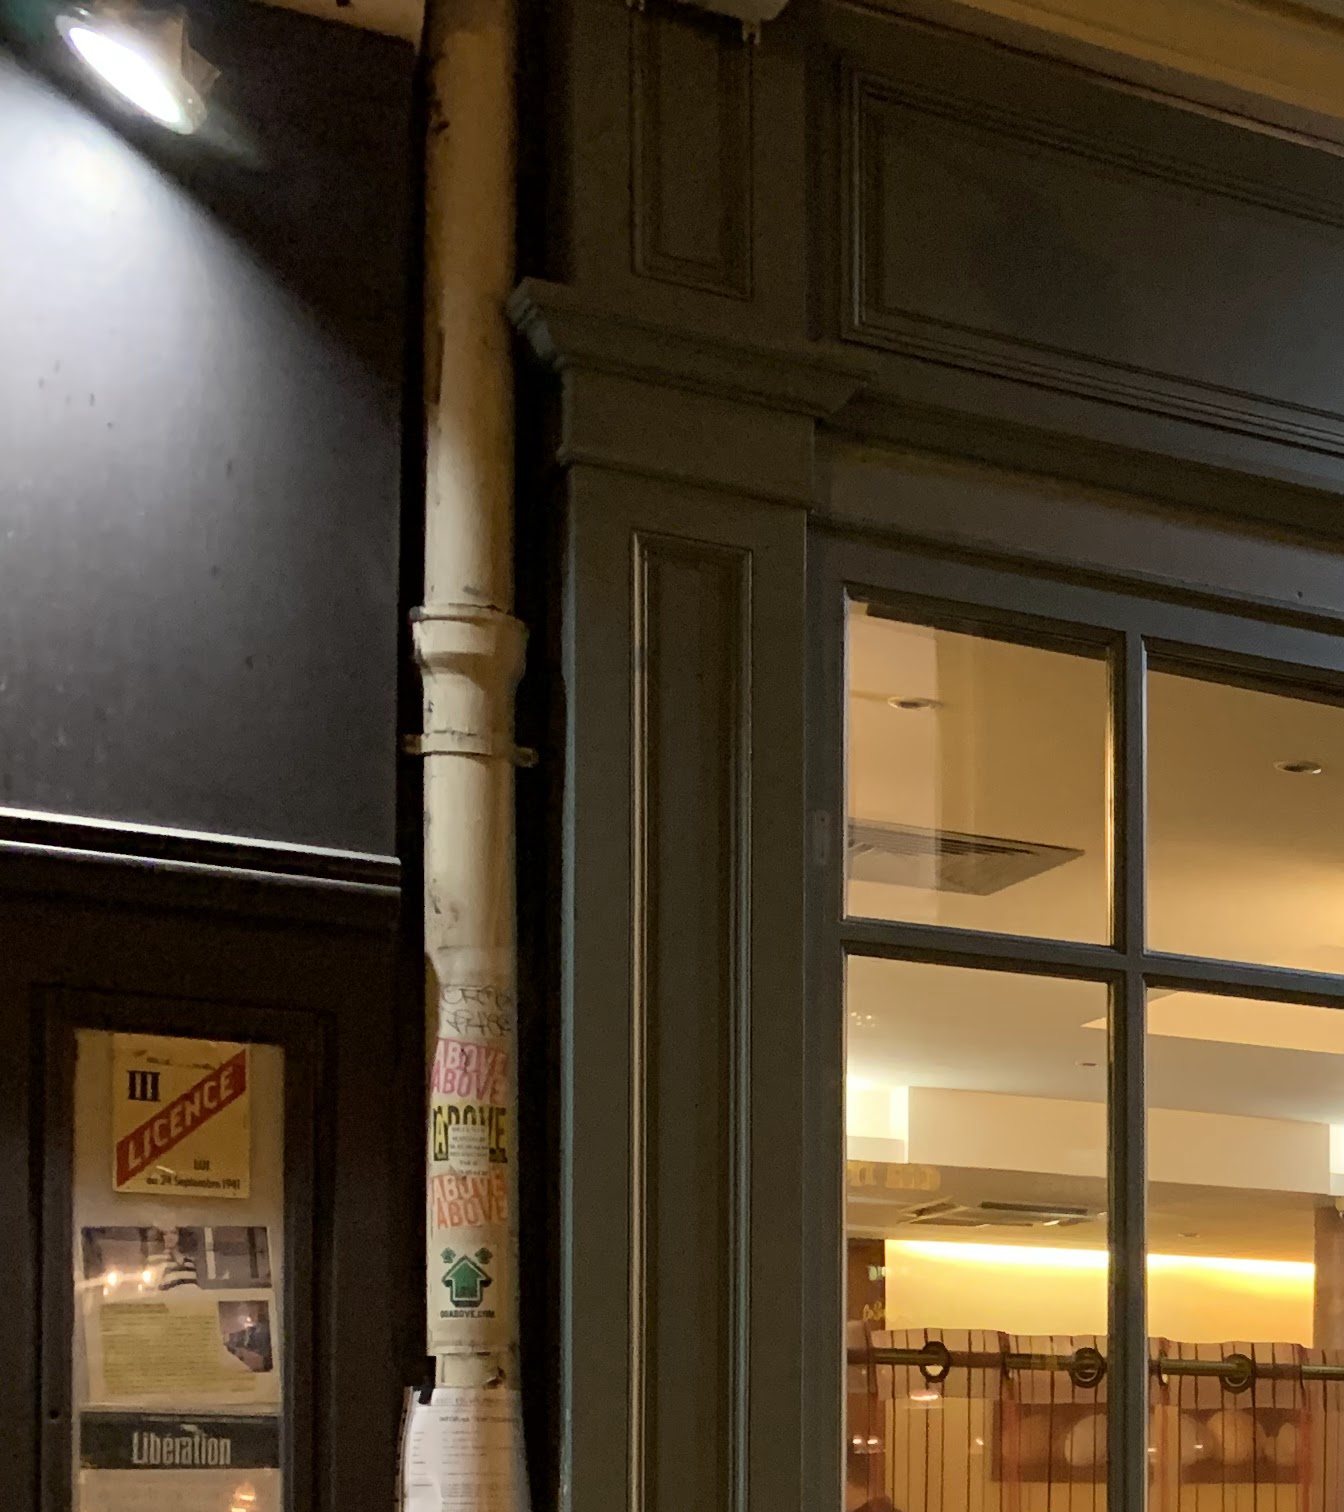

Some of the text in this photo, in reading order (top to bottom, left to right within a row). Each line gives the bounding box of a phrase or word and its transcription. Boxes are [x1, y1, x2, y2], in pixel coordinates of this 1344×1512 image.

[127, 1070, 161, 1103] III
[127, 1066, 235, 1172] LICENCE
[131, 1426, 232, 1466] Libération
